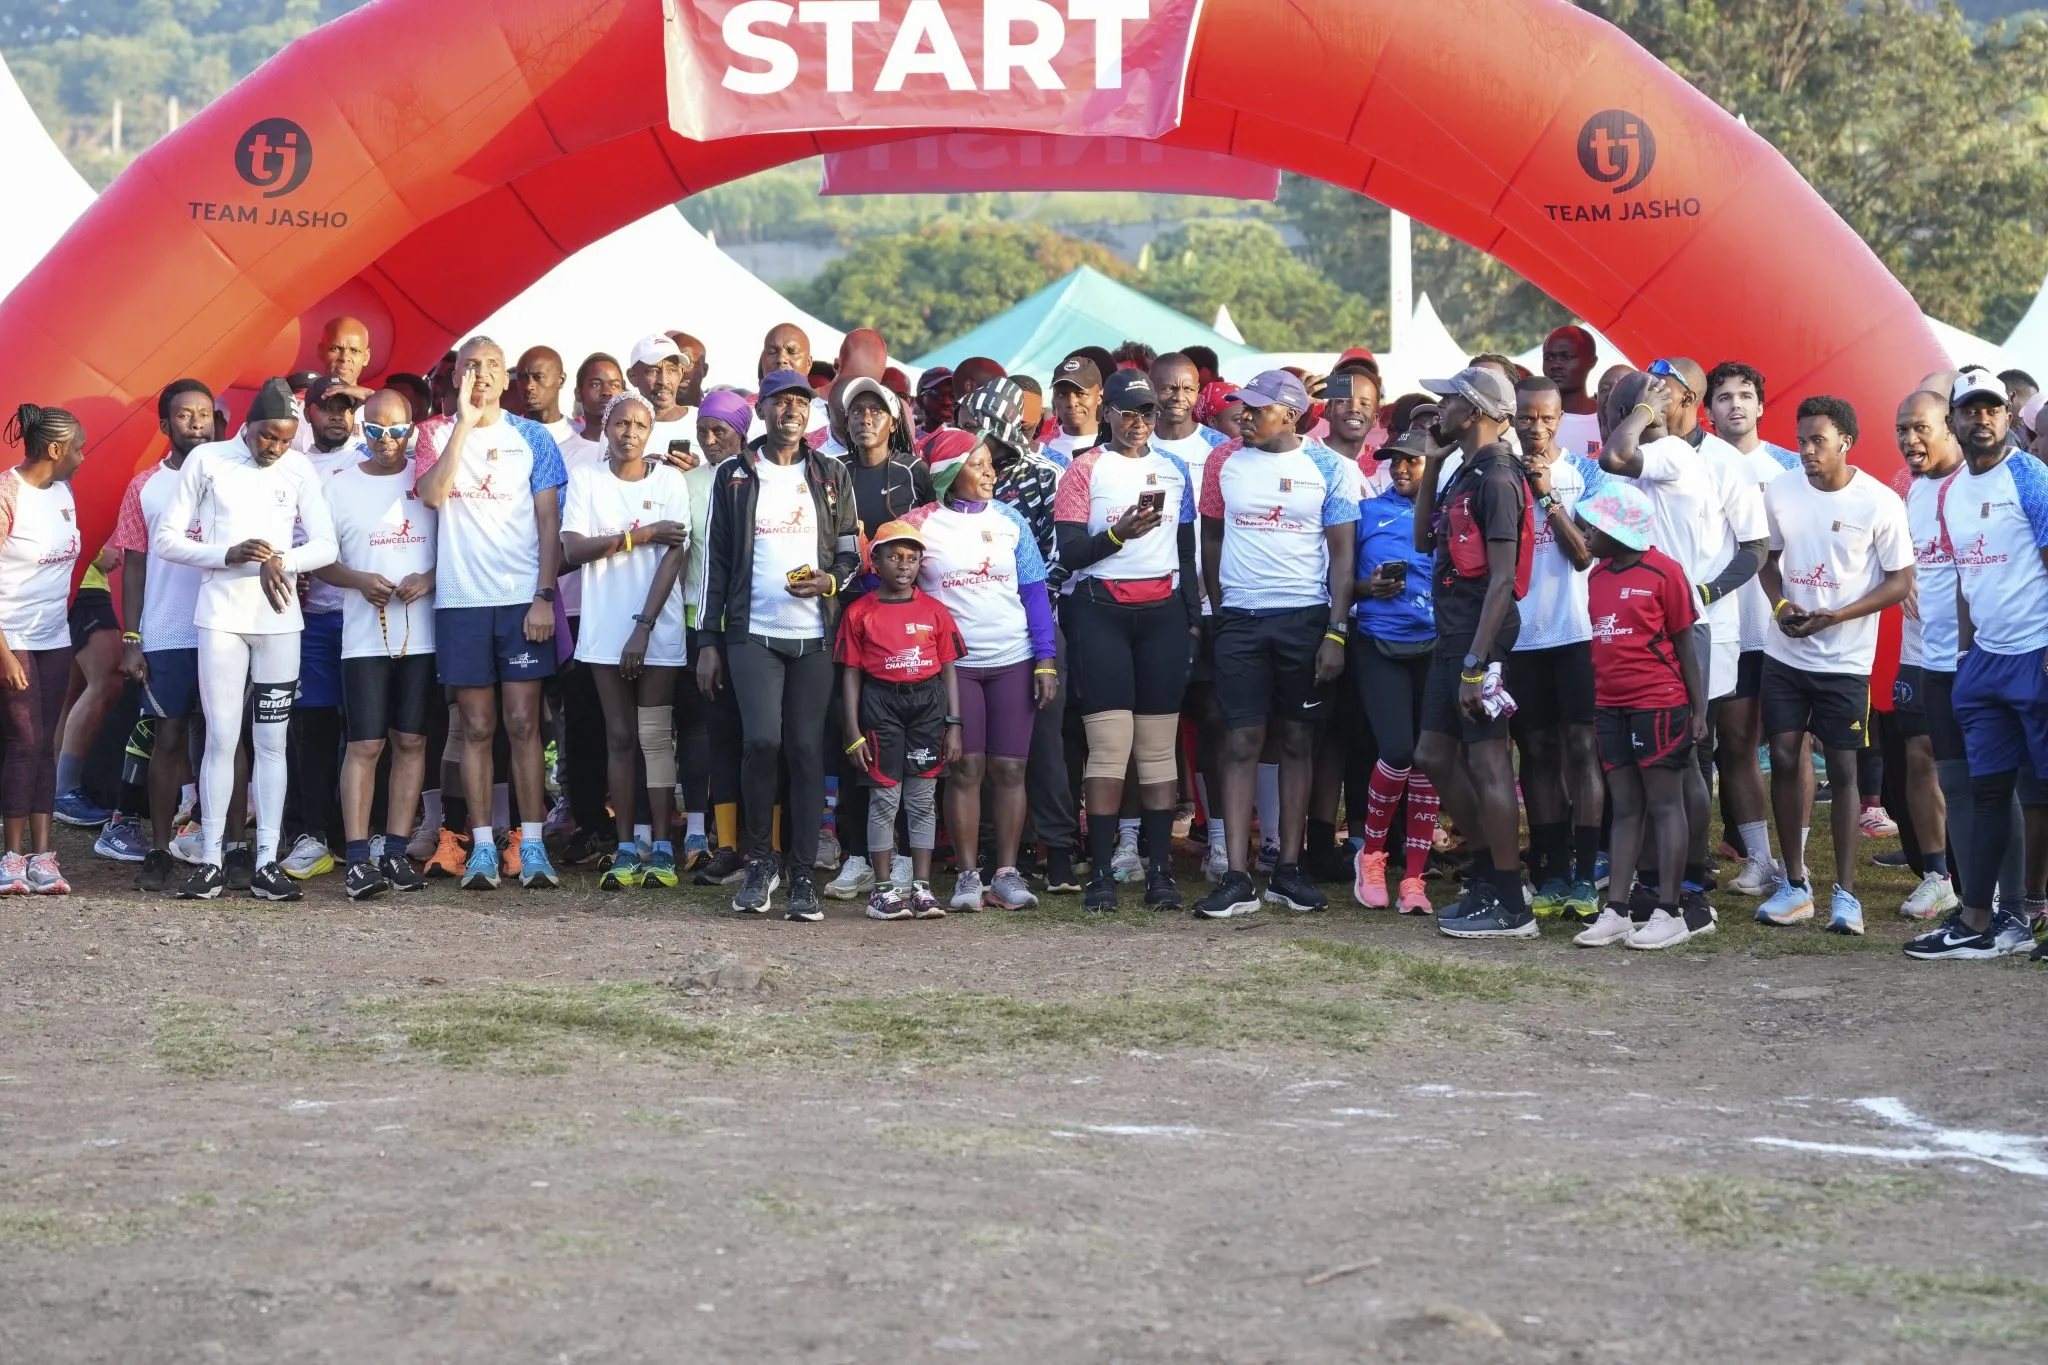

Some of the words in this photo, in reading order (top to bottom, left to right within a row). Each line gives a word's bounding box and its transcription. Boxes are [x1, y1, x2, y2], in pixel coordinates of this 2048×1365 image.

[721, 0, 1150, 95] START
[188, 201, 258, 224] TEAM
[265, 208, 348, 228] JASHO
[1544, 203, 1611, 222] TEAM
[1619, 197, 1701, 221] JASHO
[368, 530, 387, 539] VICE
[369, 536, 427, 547] CHANCELLOR'S
[940, 571, 961, 580] VICE
[942, 574, 1010, 589] CHANCELLOR'S
[1789, 577, 1841, 590] HANCELLOR'S
[885, 655, 902, 663] VICE
[885, 660, 933, 670] CHANCELLOR'S
[259, 696, 292, 709] enda
